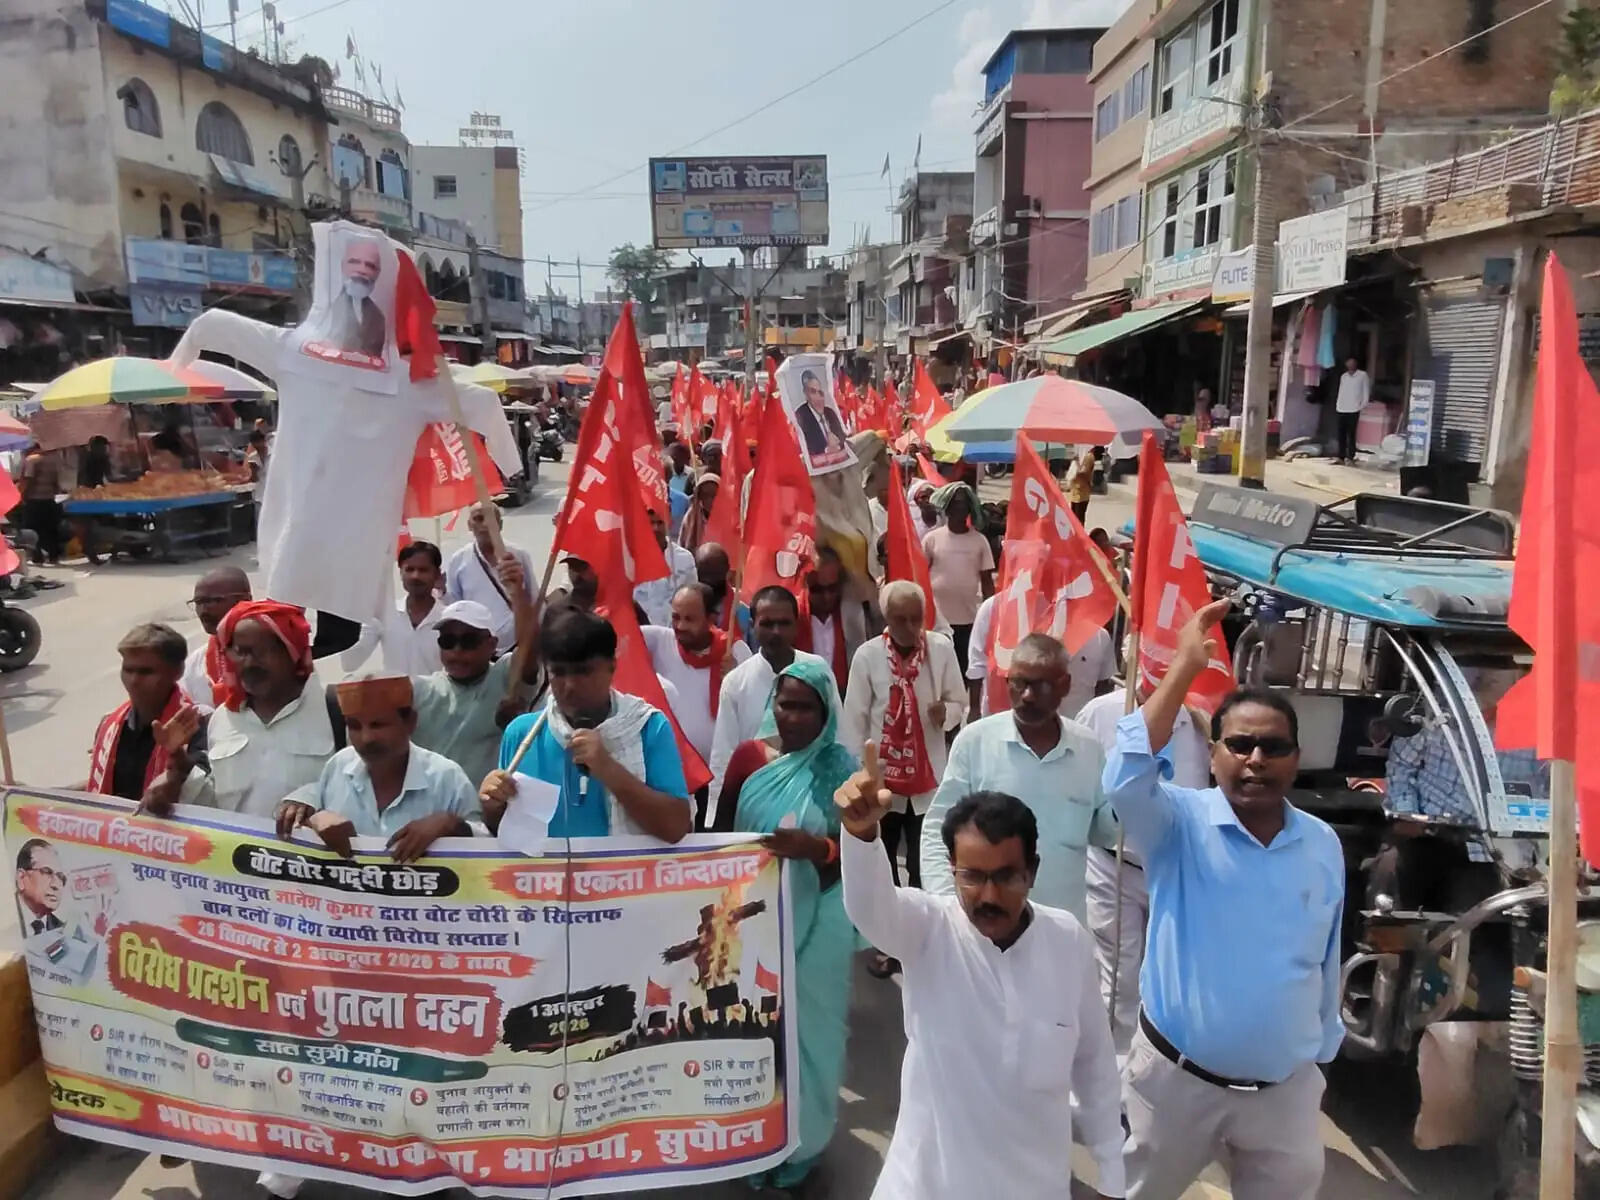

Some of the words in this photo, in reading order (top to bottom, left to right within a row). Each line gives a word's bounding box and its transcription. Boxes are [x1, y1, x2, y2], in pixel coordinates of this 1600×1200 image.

[688, 166, 738, 188] सोनी
[744, 165, 792, 187] सेल्स
[1241, 498, 1297, 527] Metro
[250, 848, 287, 875] वोट
[288, 856, 324, 880] चोर
[390, 867, 440, 895] छोड़
[513, 872, 566, 895] वाम
[573, 868, 647, 895] एकता
[132, 862, 166, 881] मुख्य
[170, 870, 208, 889] चुनाव
[213, 879, 270, 901] आयुक्त
[325, 899, 376, 920] कुमार
[379, 905, 418, 922] द्वारा
[423, 904, 461, 922] वोट
[466, 905, 510, 923] चोरी
[515, 905, 537, 923] के
[542, 906, 623, 925] खिलाफ
[237, 906, 272, 924] दलों
[273, 912, 294, 931] का
[298, 915, 323, 936] देश
[326, 925, 379, 941] व्यापी
[292, 943, 302, 958] 2
[119, 932, 183, 992] विरोध
[187, 959, 269, 1013] प्रदर्शन
[275, 989, 307, 1020] एवं
[312, 986, 407, 1037] पुतला
[414, 993, 490, 1037] दहन
[529, 1004, 539, 1018] 1
[254, 1038, 300, 1058] सात
[353, 1048, 400, 1071] मांग
[703, 1060, 722, 1071] SIR
[51, 1080, 106, 1109] वेदक
[435, 1087, 467, 1102] चुनाव
[157, 1104, 258, 1143] भाकपा
[654, 1119, 765, 1164] सुपौल
